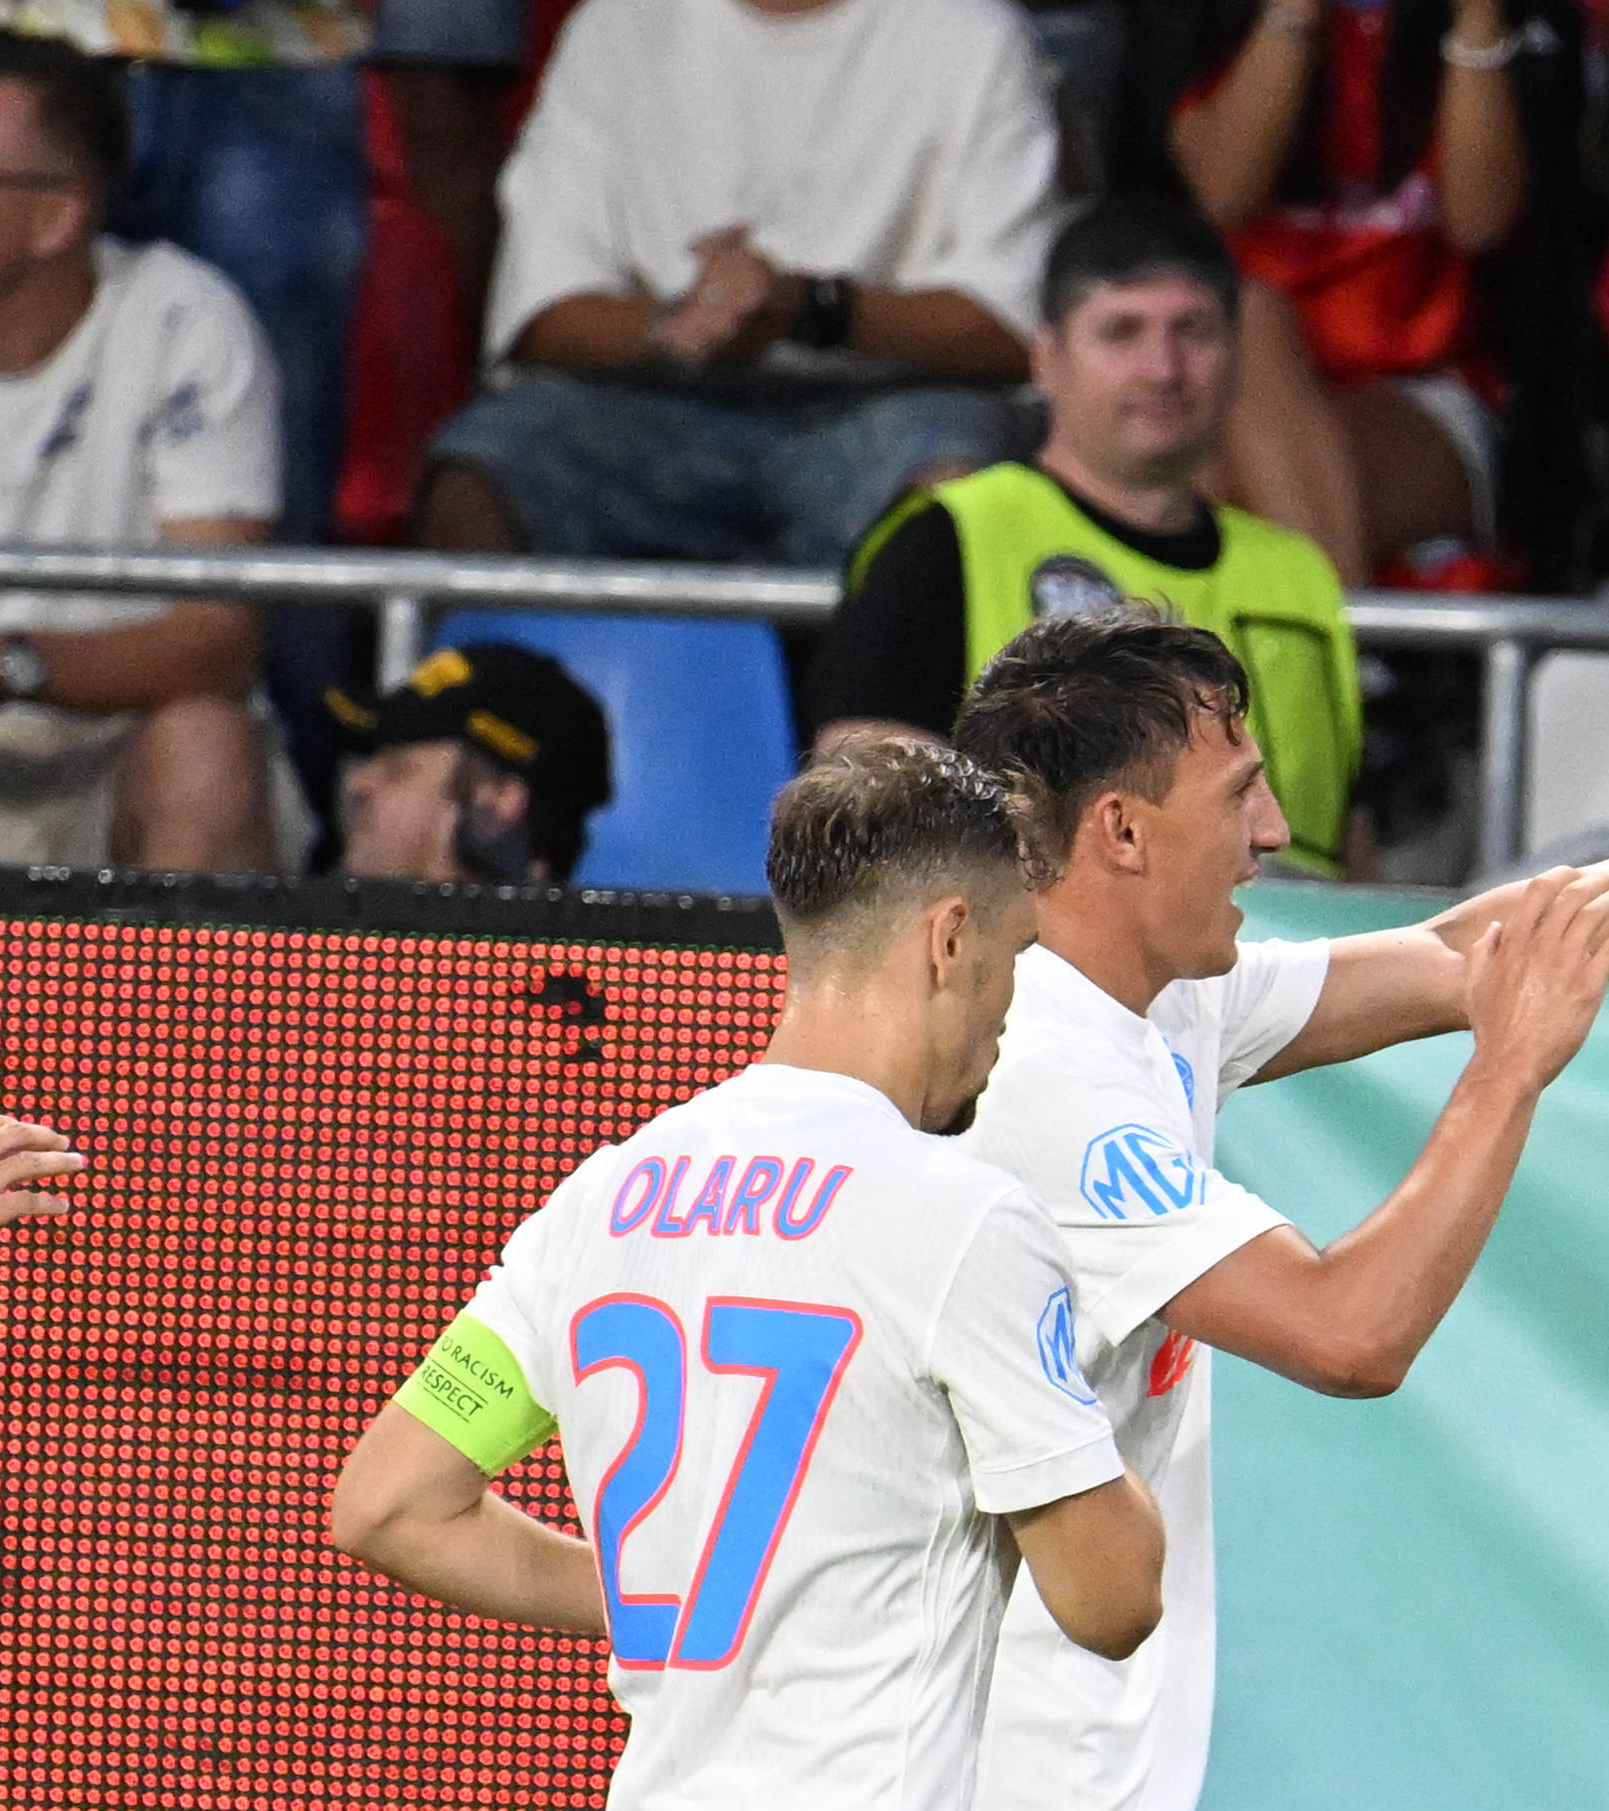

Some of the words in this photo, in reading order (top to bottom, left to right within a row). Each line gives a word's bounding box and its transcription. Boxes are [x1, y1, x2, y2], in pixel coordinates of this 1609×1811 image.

[609, 1155, 854, 1241] OLARU
[451, 1345, 514, 1399] RACISM
[570, 1293, 862, 1672] 27
